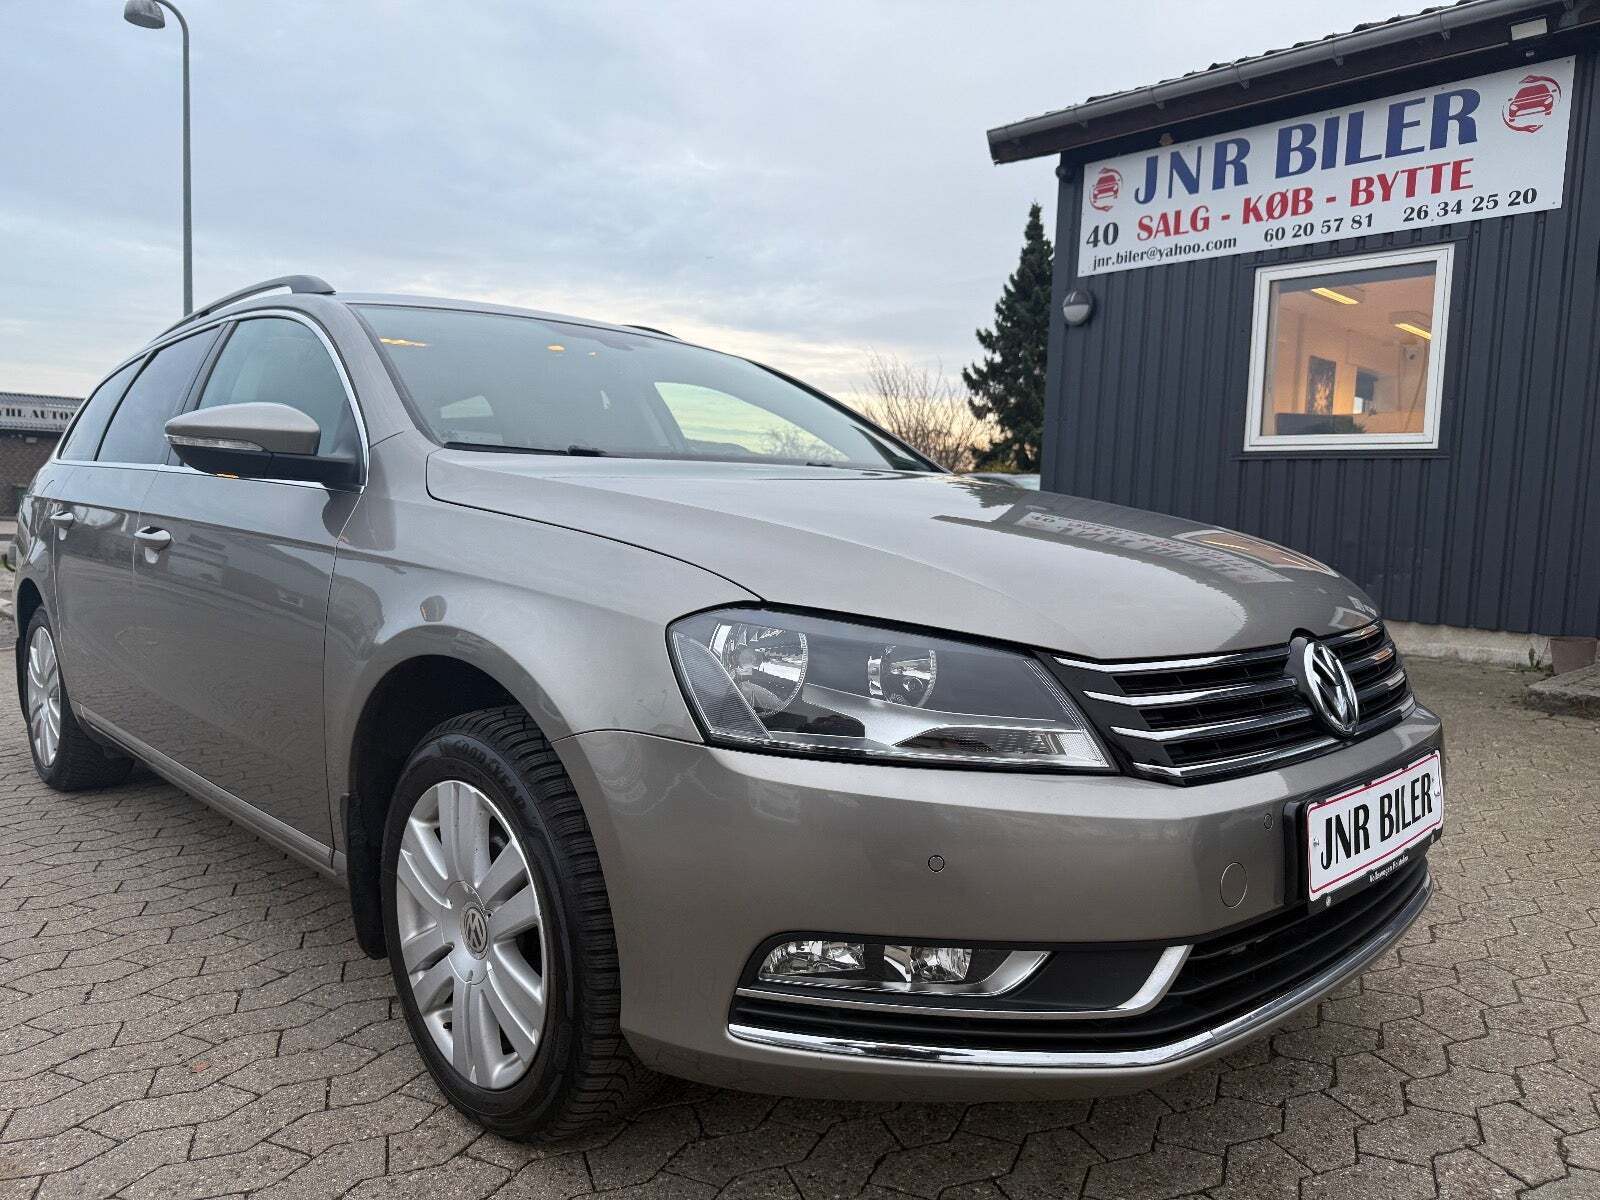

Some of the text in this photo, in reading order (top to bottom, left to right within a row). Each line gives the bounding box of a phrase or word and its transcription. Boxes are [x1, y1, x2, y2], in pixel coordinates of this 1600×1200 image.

[1134, 88, 1482, 205] JNR BILER
[1137, 205, 1210, 242] SALG
[1242, 187, 1313, 224] KØB
[1350, 158, 1474, 207] BYTTE
[1403, 187, 1538, 222] 26 34 25 20
[1086, 222, 1119, 248] 40
[1264, 213, 1373, 243] 60 20 57 81
[1093, 236, 1237, 271] jnr.biler@yahoo.com
[1320, 772, 1433, 870] JNR BILER
